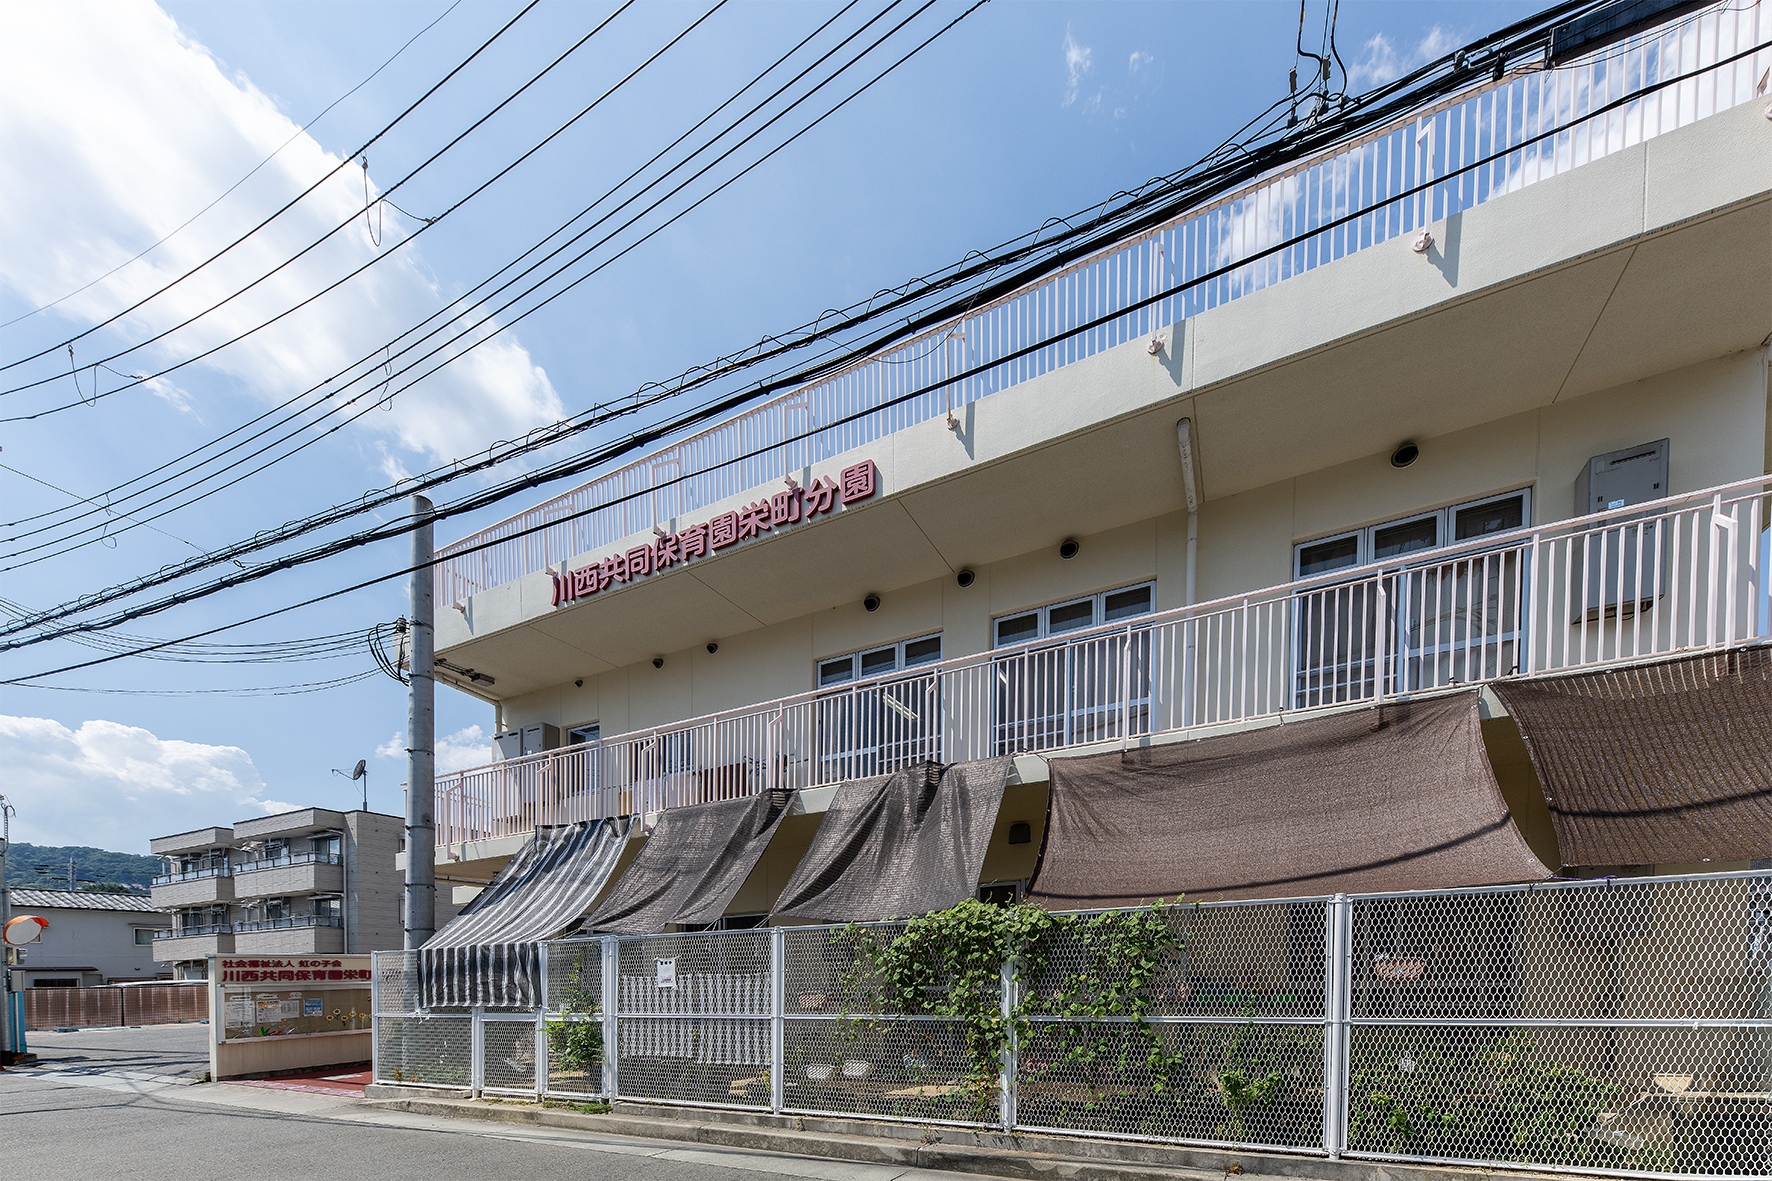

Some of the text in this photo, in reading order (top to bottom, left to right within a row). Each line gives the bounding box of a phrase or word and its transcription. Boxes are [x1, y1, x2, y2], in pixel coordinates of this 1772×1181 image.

[550, 459, 876, 606] 川西共同保育園栄町分園
[222, 960, 342, 968] 社会福祉法人 虹の子会
